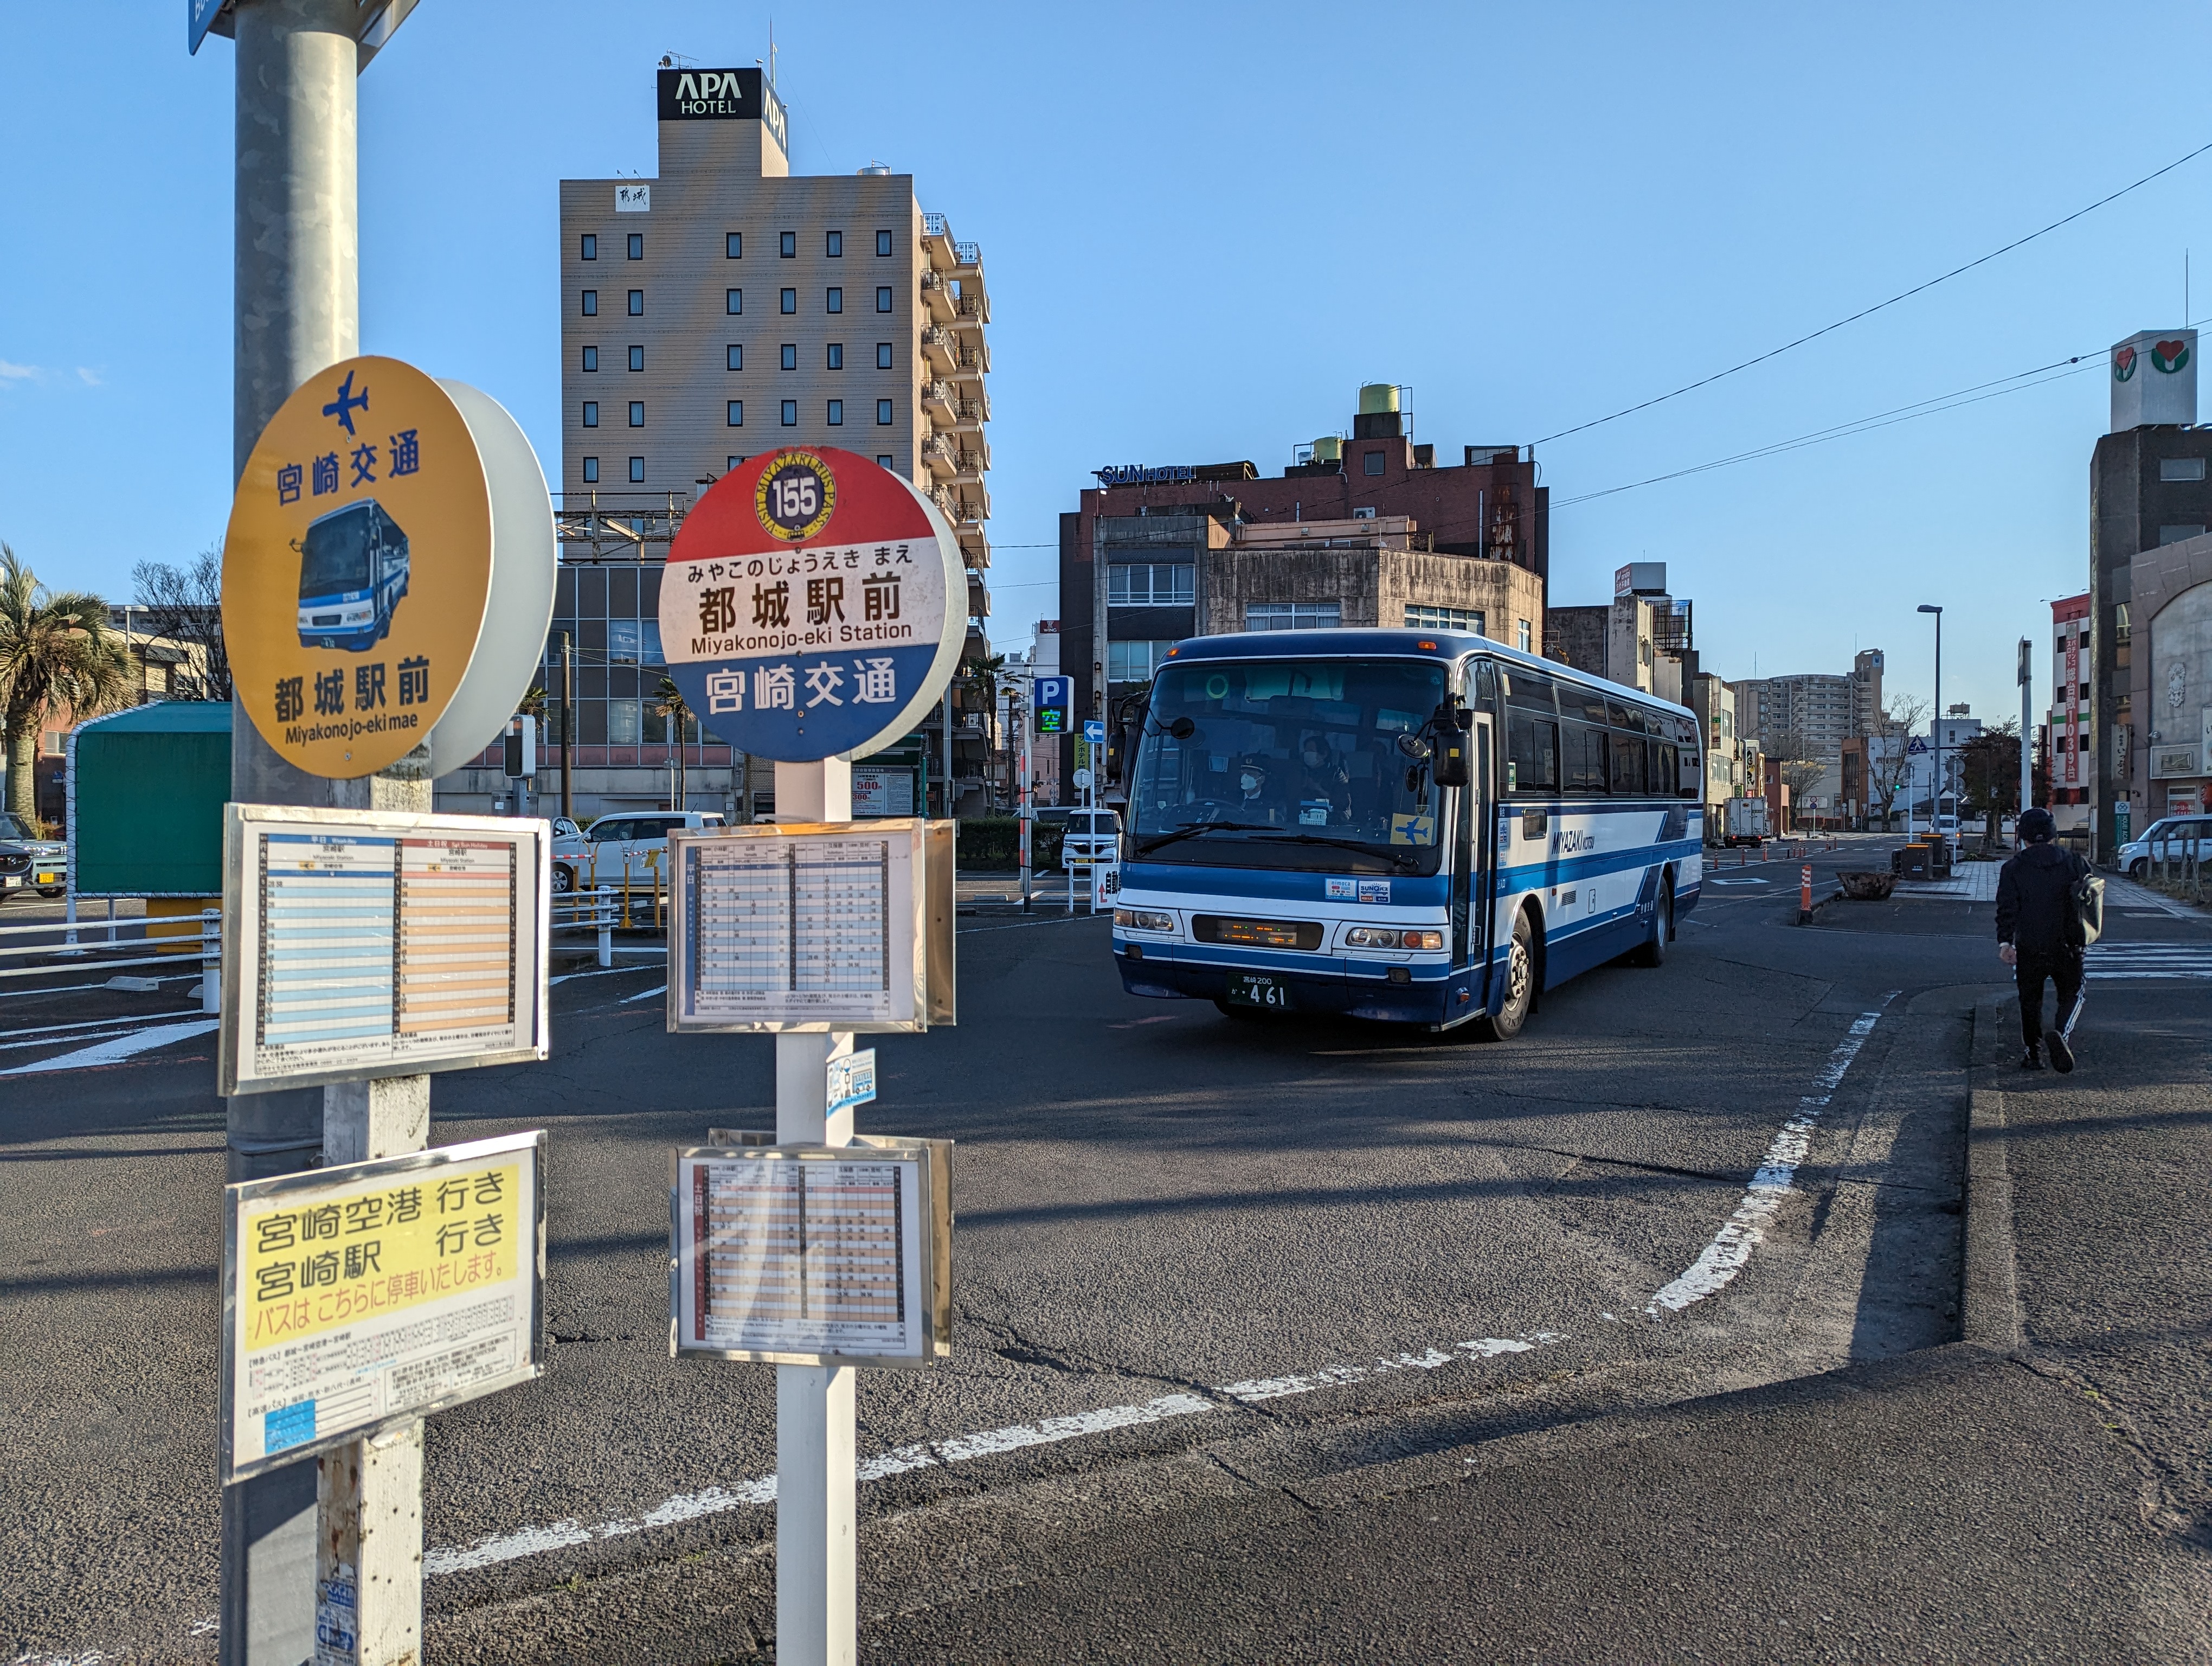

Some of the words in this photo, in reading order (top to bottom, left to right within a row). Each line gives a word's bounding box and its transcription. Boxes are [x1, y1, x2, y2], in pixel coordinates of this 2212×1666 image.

[676, 73, 742, 99] APA
[681, 100, 736, 114] HOTEL
[764, 87, 786, 148] APA
[277, 429, 420, 505] 宮崎交通
[1102, 464, 1144, 484] SUN
[1146, 466, 1196, 480] HOTEL
[773, 477, 816, 518] 155
[688, 549, 859, 583] みやこのじょうえき
[874, 545, 912, 566] まえ
[698, 571, 902, 635] 都城駅前
[692, 627, 832, 655] Miyakonojo-eki
[840, 623, 911, 643] Station
[275, 656, 429, 723] 都城駅前
[706, 657, 896, 715] 宮崎交通
[1043, 681, 1059, 704] P
[1552, 830, 1583, 855] MIYAZAKI
[687, 864, 695, 884] 平日
[1502, 1009, 1524, 1027] DUNLO
[257, 1187, 422, 1253] 宮崎空港
[437, 1171, 504, 1214] 行き
[256, 1241, 381, 1302] 宮崎駅
[436, 1213, 504, 1257] 行き
